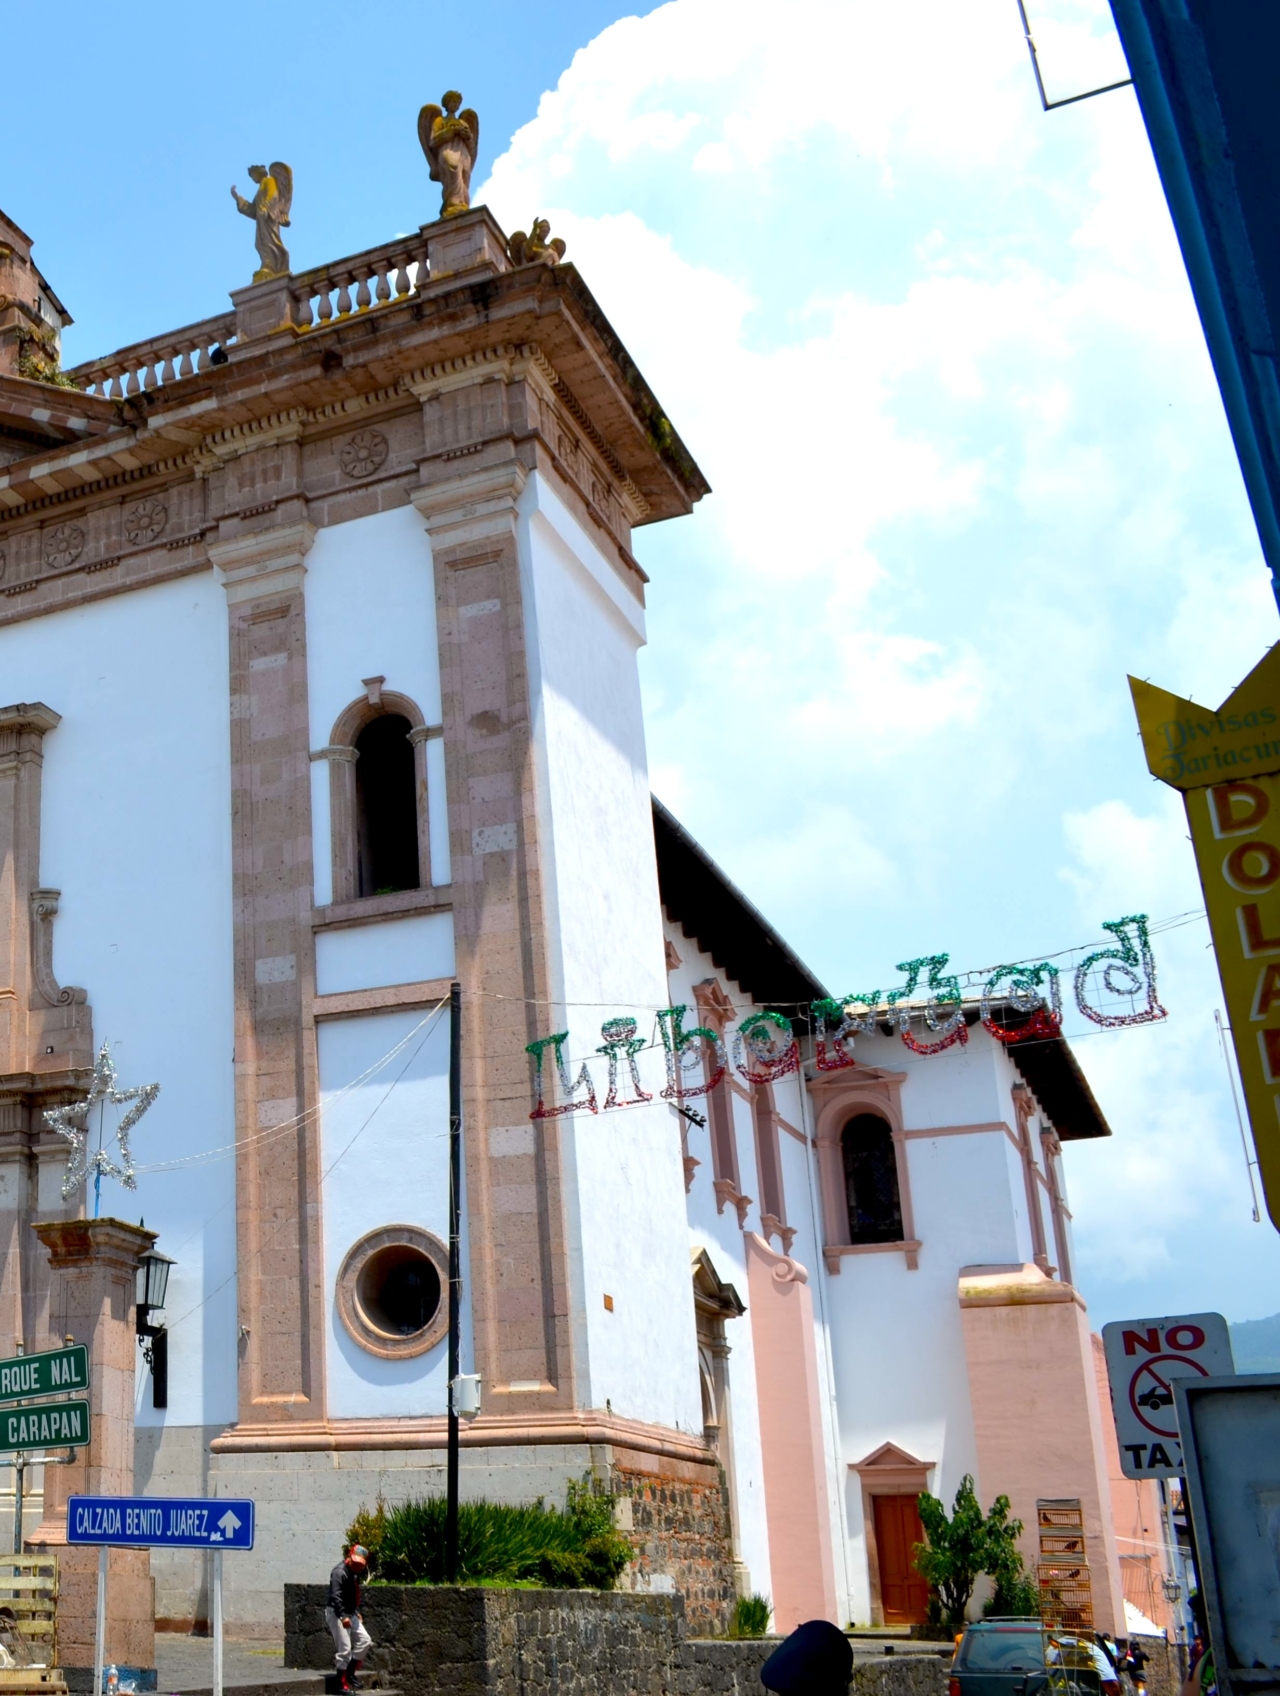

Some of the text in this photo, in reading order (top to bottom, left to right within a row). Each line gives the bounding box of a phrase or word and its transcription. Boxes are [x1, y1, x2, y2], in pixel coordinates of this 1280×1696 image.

[1156, 707, 1277, 752] Divisas
[526, 914, 1168, 1119] Libertad
[1122, 1325, 1206, 1356] NO
[51, 1356, 81, 1386] NAL
[8, 1410, 81, 1443] CARAPAN
[76, 1507, 121, 1534] CALZADA
[126, 1508, 163, 1536] BENITO
